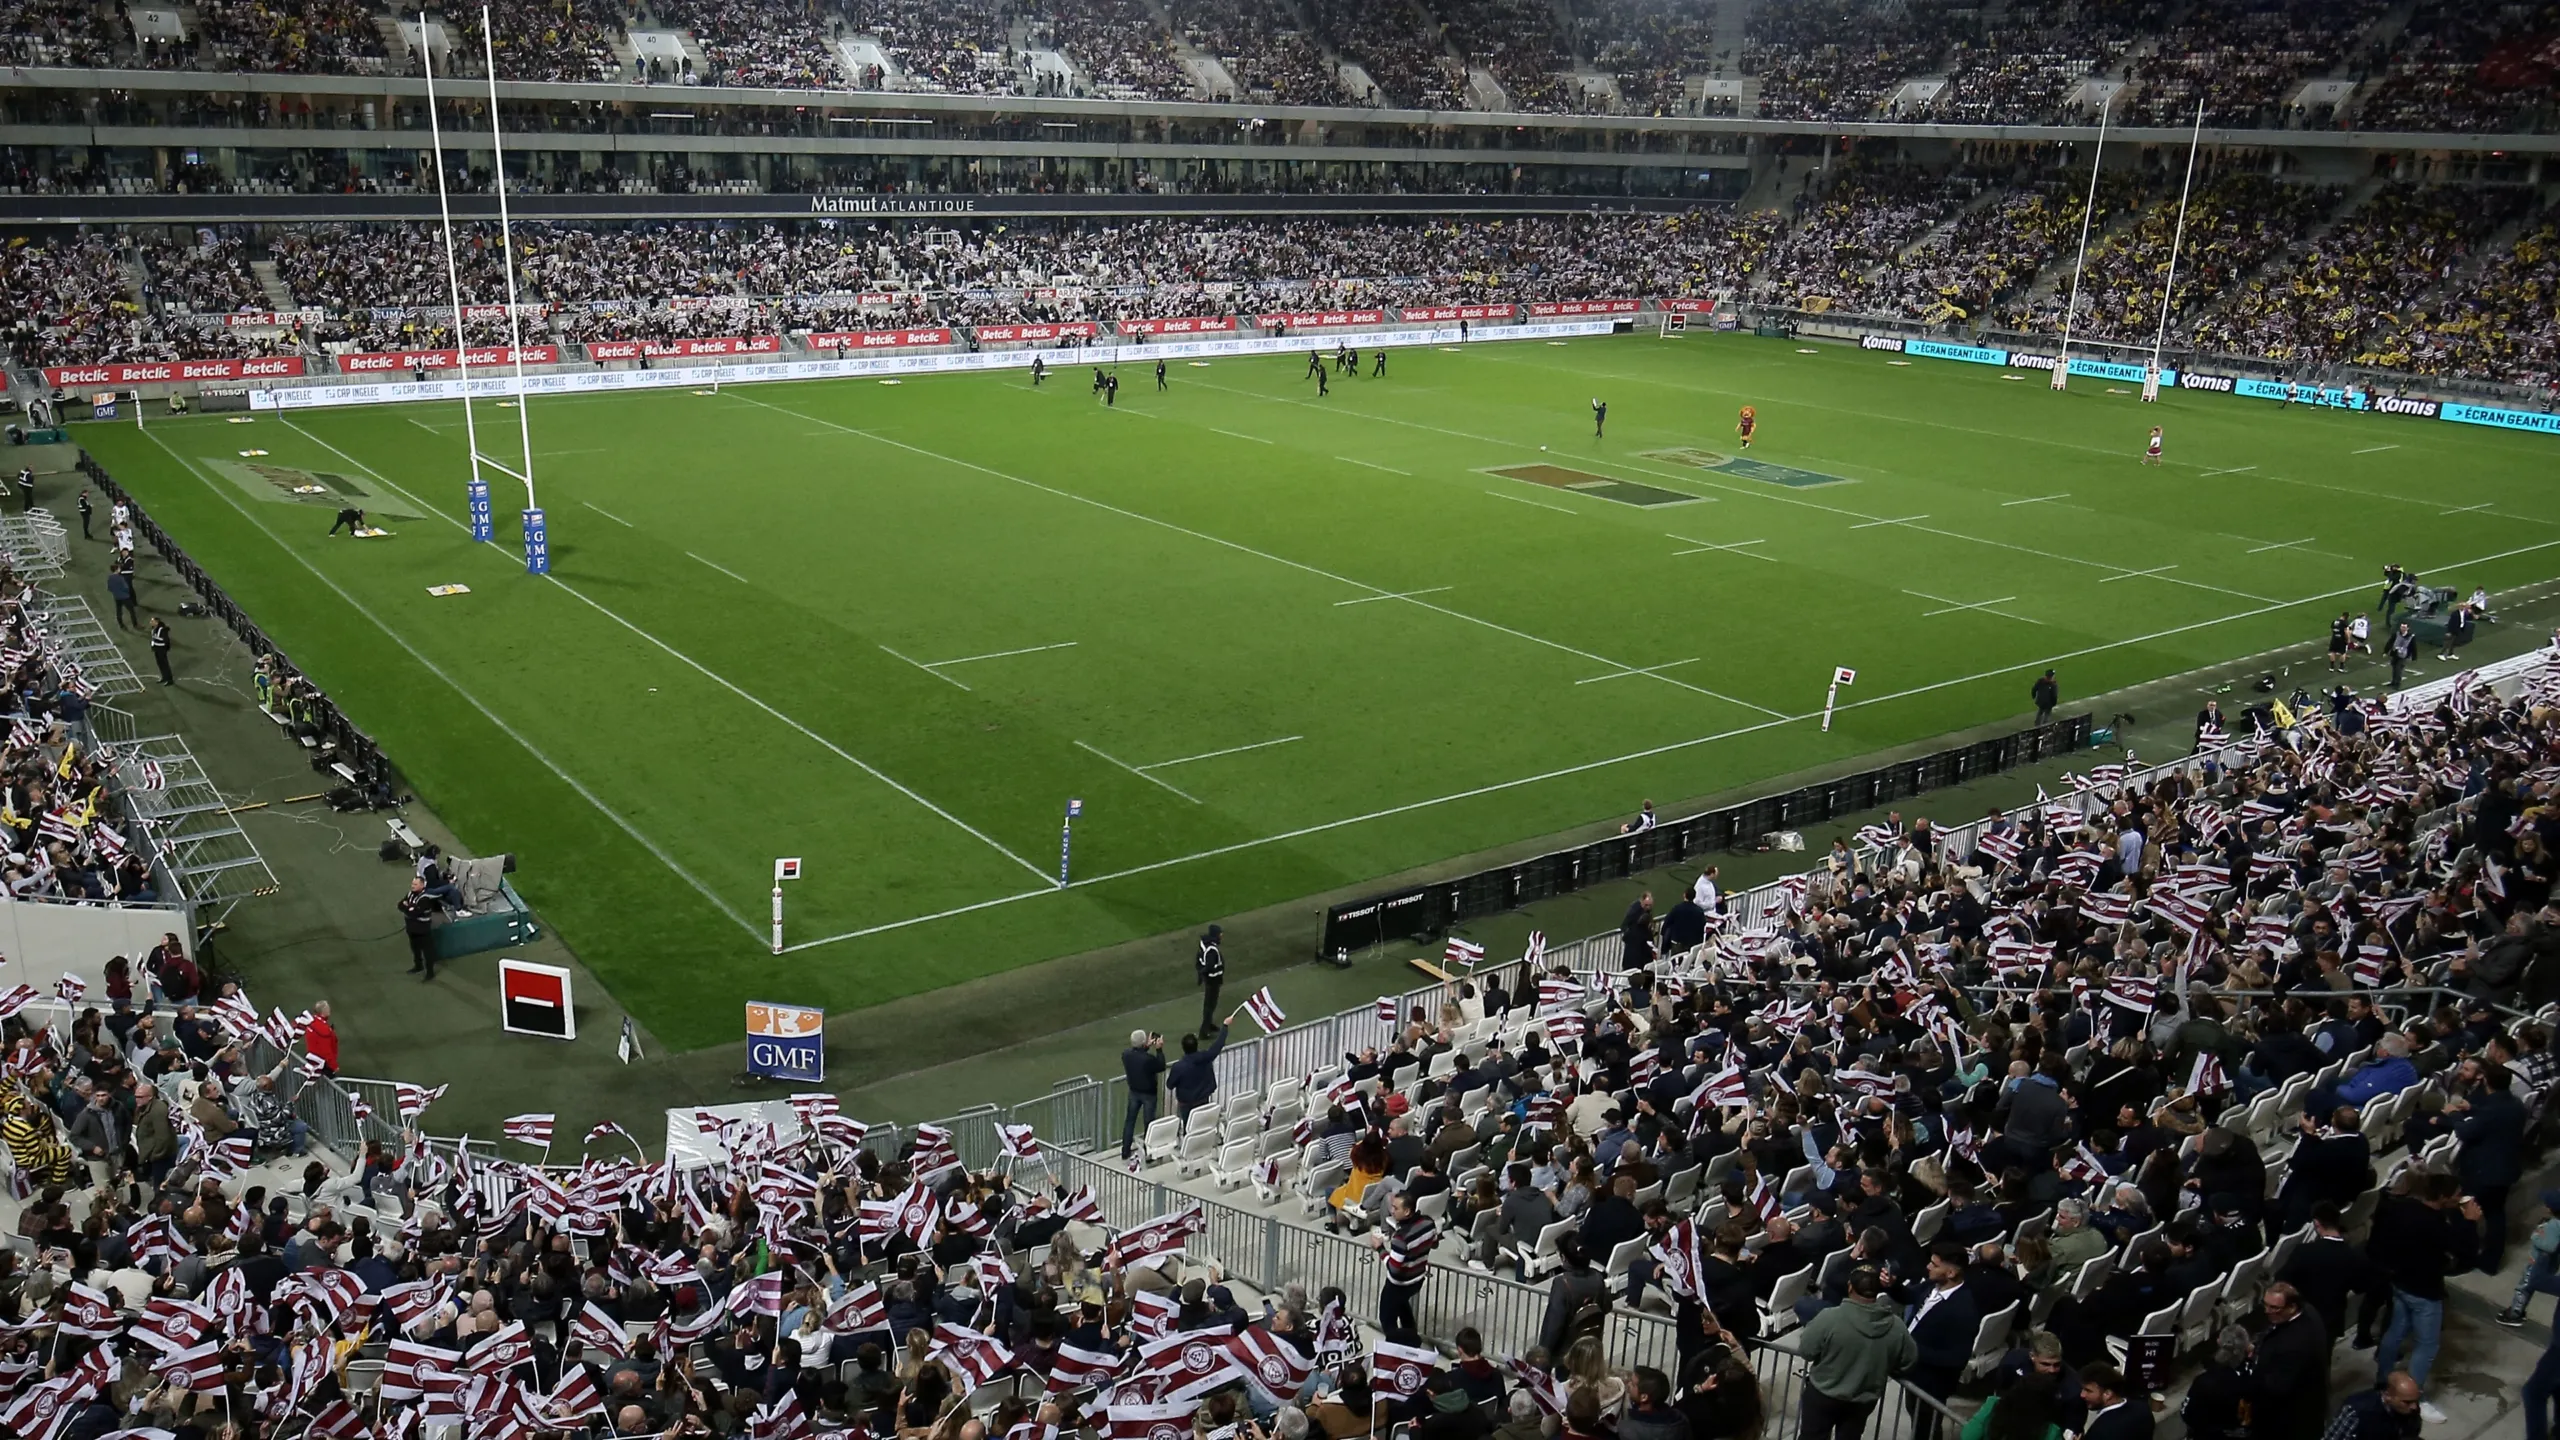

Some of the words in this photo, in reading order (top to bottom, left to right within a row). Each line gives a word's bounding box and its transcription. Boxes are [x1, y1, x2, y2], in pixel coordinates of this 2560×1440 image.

[148, 15, 159, 23] 42
[811, 196, 877, 212] Matmut
[880, 200, 974, 212] ATLANTIQUE
[861, 295, 890, 304] Betclic
[232, 314, 269, 325] Betclic
[1164, 321, 1192, 331] Betclic
[1293, 315, 1318, 326] Betclic
[1323, 314, 1347, 324] Betclic
[1352, 312, 1377, 323] Betclic
[864, 334, 896, 346] Betclic
[908, 332, 939, 344] Betclic
[983, 329, 1013, 340] Betclic
[1021, 327, 1051, 338] Betclic
[598, 346, 635, 359] Betclic
[690, 342, 727, 354] Betclic
[1921, 344, 1946, 356] ÉCRAN
[1948, 347, 1973, 359] GEANT
[1975, 350, 1990, 361] LED
[350, 356, 393, 370] Betclic
[2077, 361, 2106, 374] ÉCRAN
[2108, 366, 2137, 379] GEANT
[61, 369, 109, 384] Betclic
[122, 366, 171, 381] Betclic
[183, 363, 230, 378] Betclic
[242, 360, 288, 375] Betclic
[284, 390, 312, 401] INGELEC
[337, 389, 350, 399] CAP
[352, 386, 379, 397] INGELEC
[417, 383, 444, 394] INGELEC
[96, 405, 115, 417] GMF
[2465, 407, 2504, 423] ÉCRAN
[2507, 413, 2546, 428] GEANT
[479, 501, 489, 537] GMF
[534, 531, 545, 569] GMF
[753, 1043, 816, 1070] GMF
